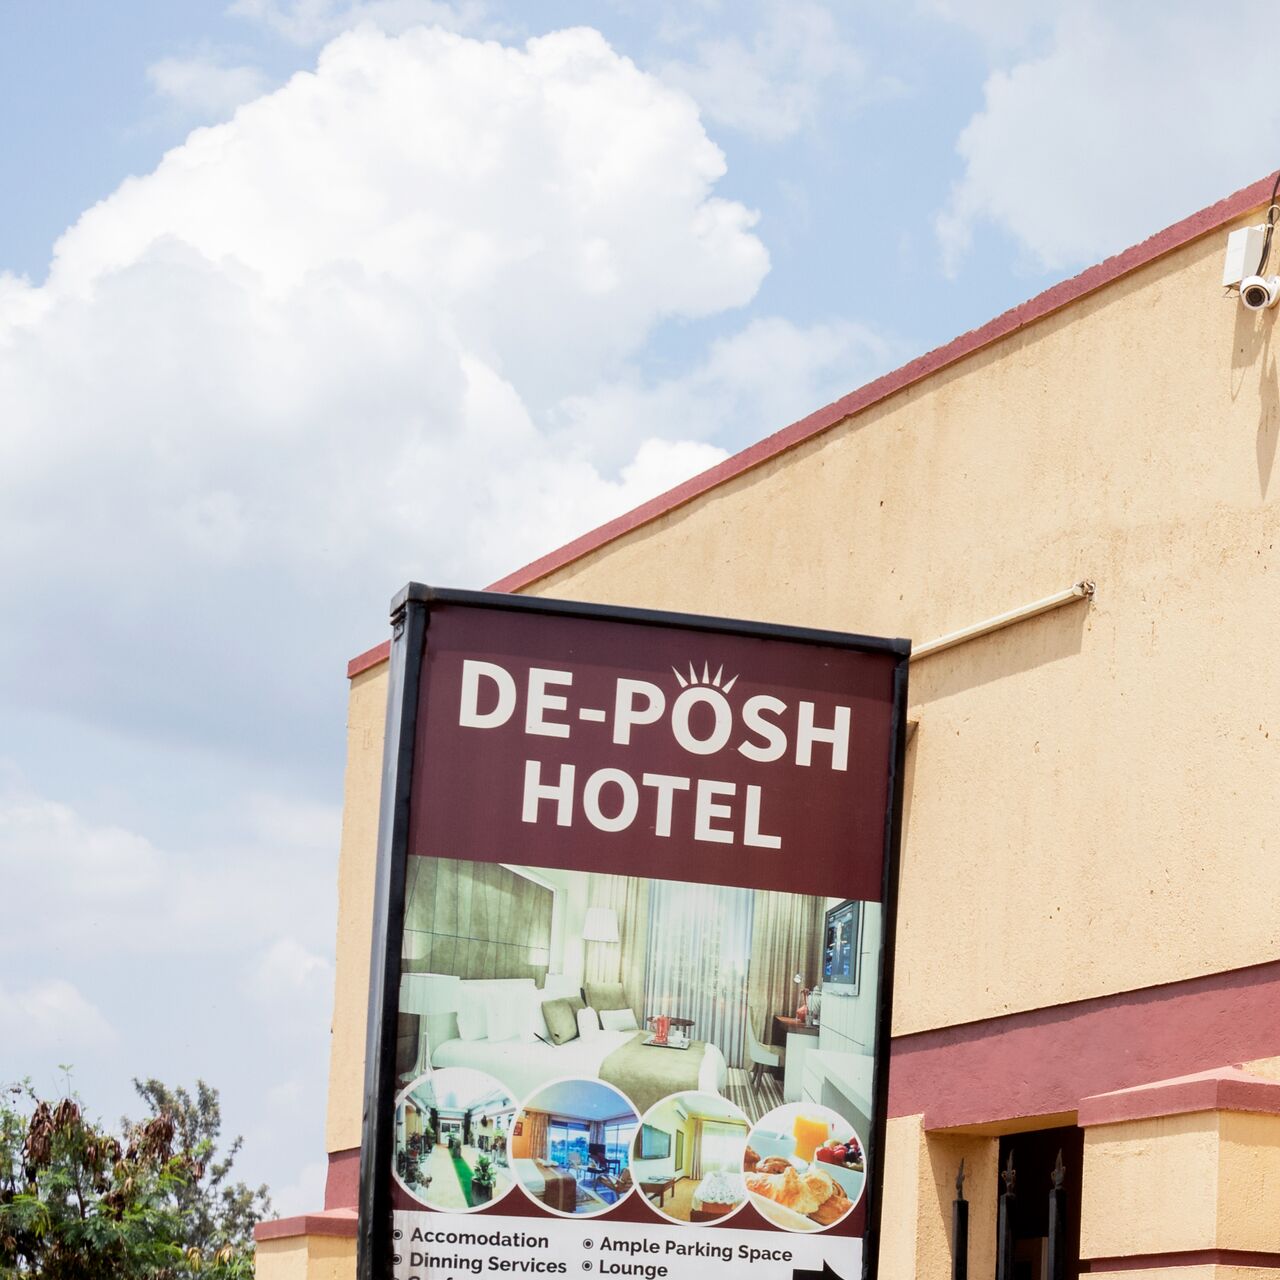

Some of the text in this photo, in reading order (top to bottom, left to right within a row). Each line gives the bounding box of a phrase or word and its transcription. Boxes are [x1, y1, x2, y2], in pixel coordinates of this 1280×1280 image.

[458, 660, 852, 771] DE-POSH
[520, 760, 783, 850] HOTEL
[410, 1227, 549, 1248] Accomodation
[600, 1236, 793, 1263] Ample Parking Space
[409, 1252, 567, 1274] Dinning Services
[599, 1259, 668, 1280] Lounge
